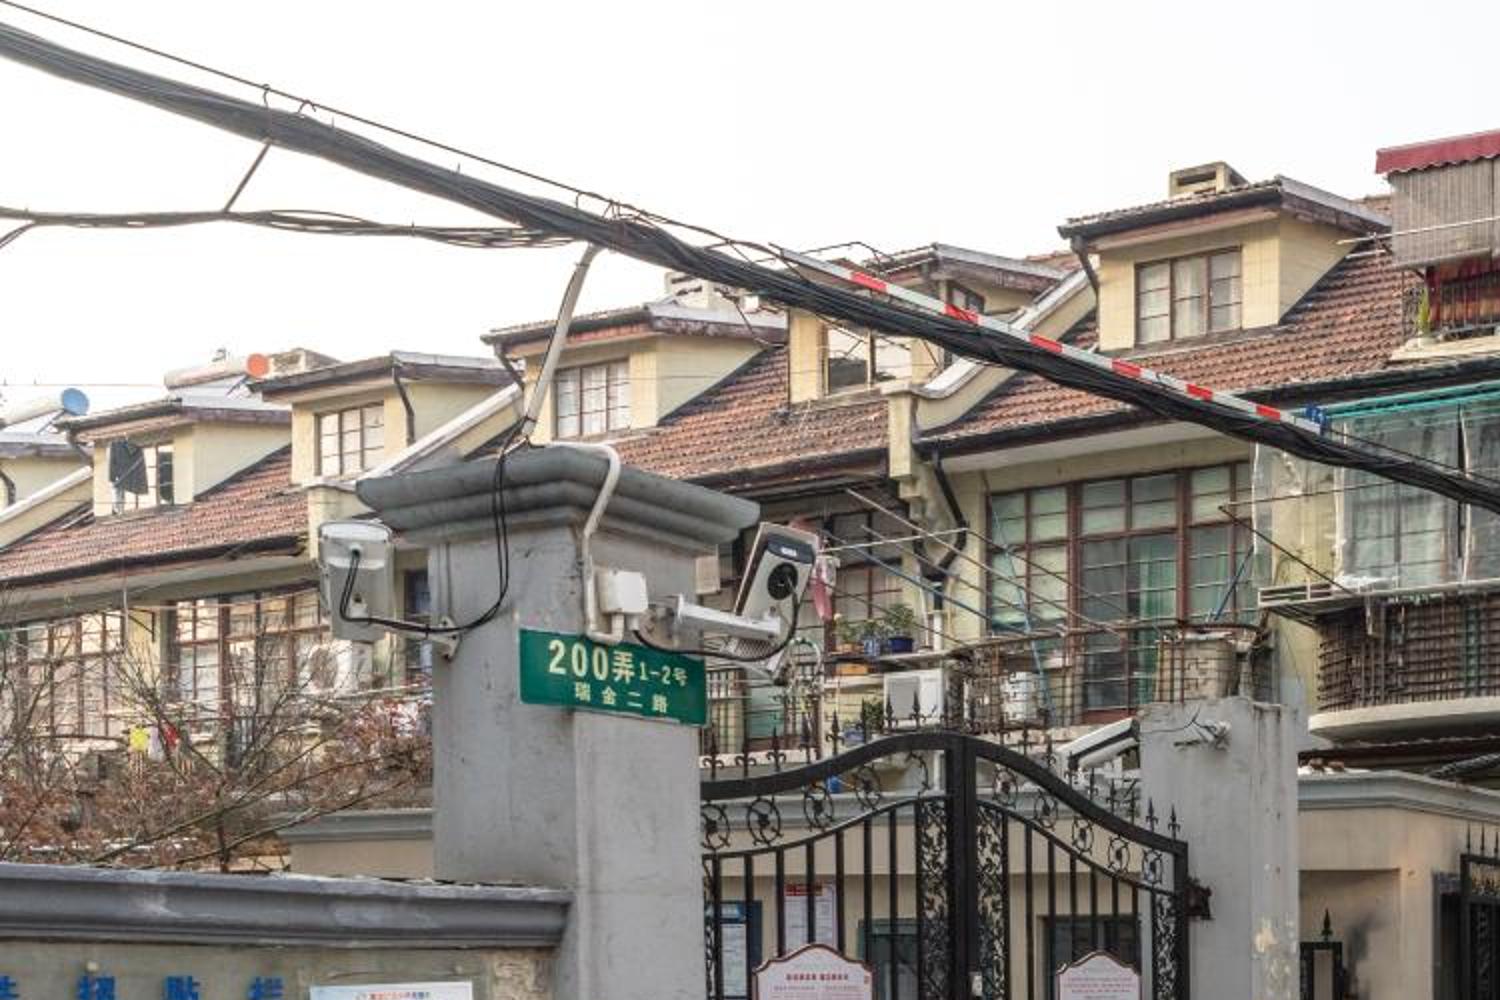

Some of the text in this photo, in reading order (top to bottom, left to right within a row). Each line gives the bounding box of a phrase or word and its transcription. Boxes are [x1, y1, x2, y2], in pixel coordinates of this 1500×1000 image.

[548, 639, 689, 687] 200弄1-2号
[575, 681, 669, 714] 瑞金二路
